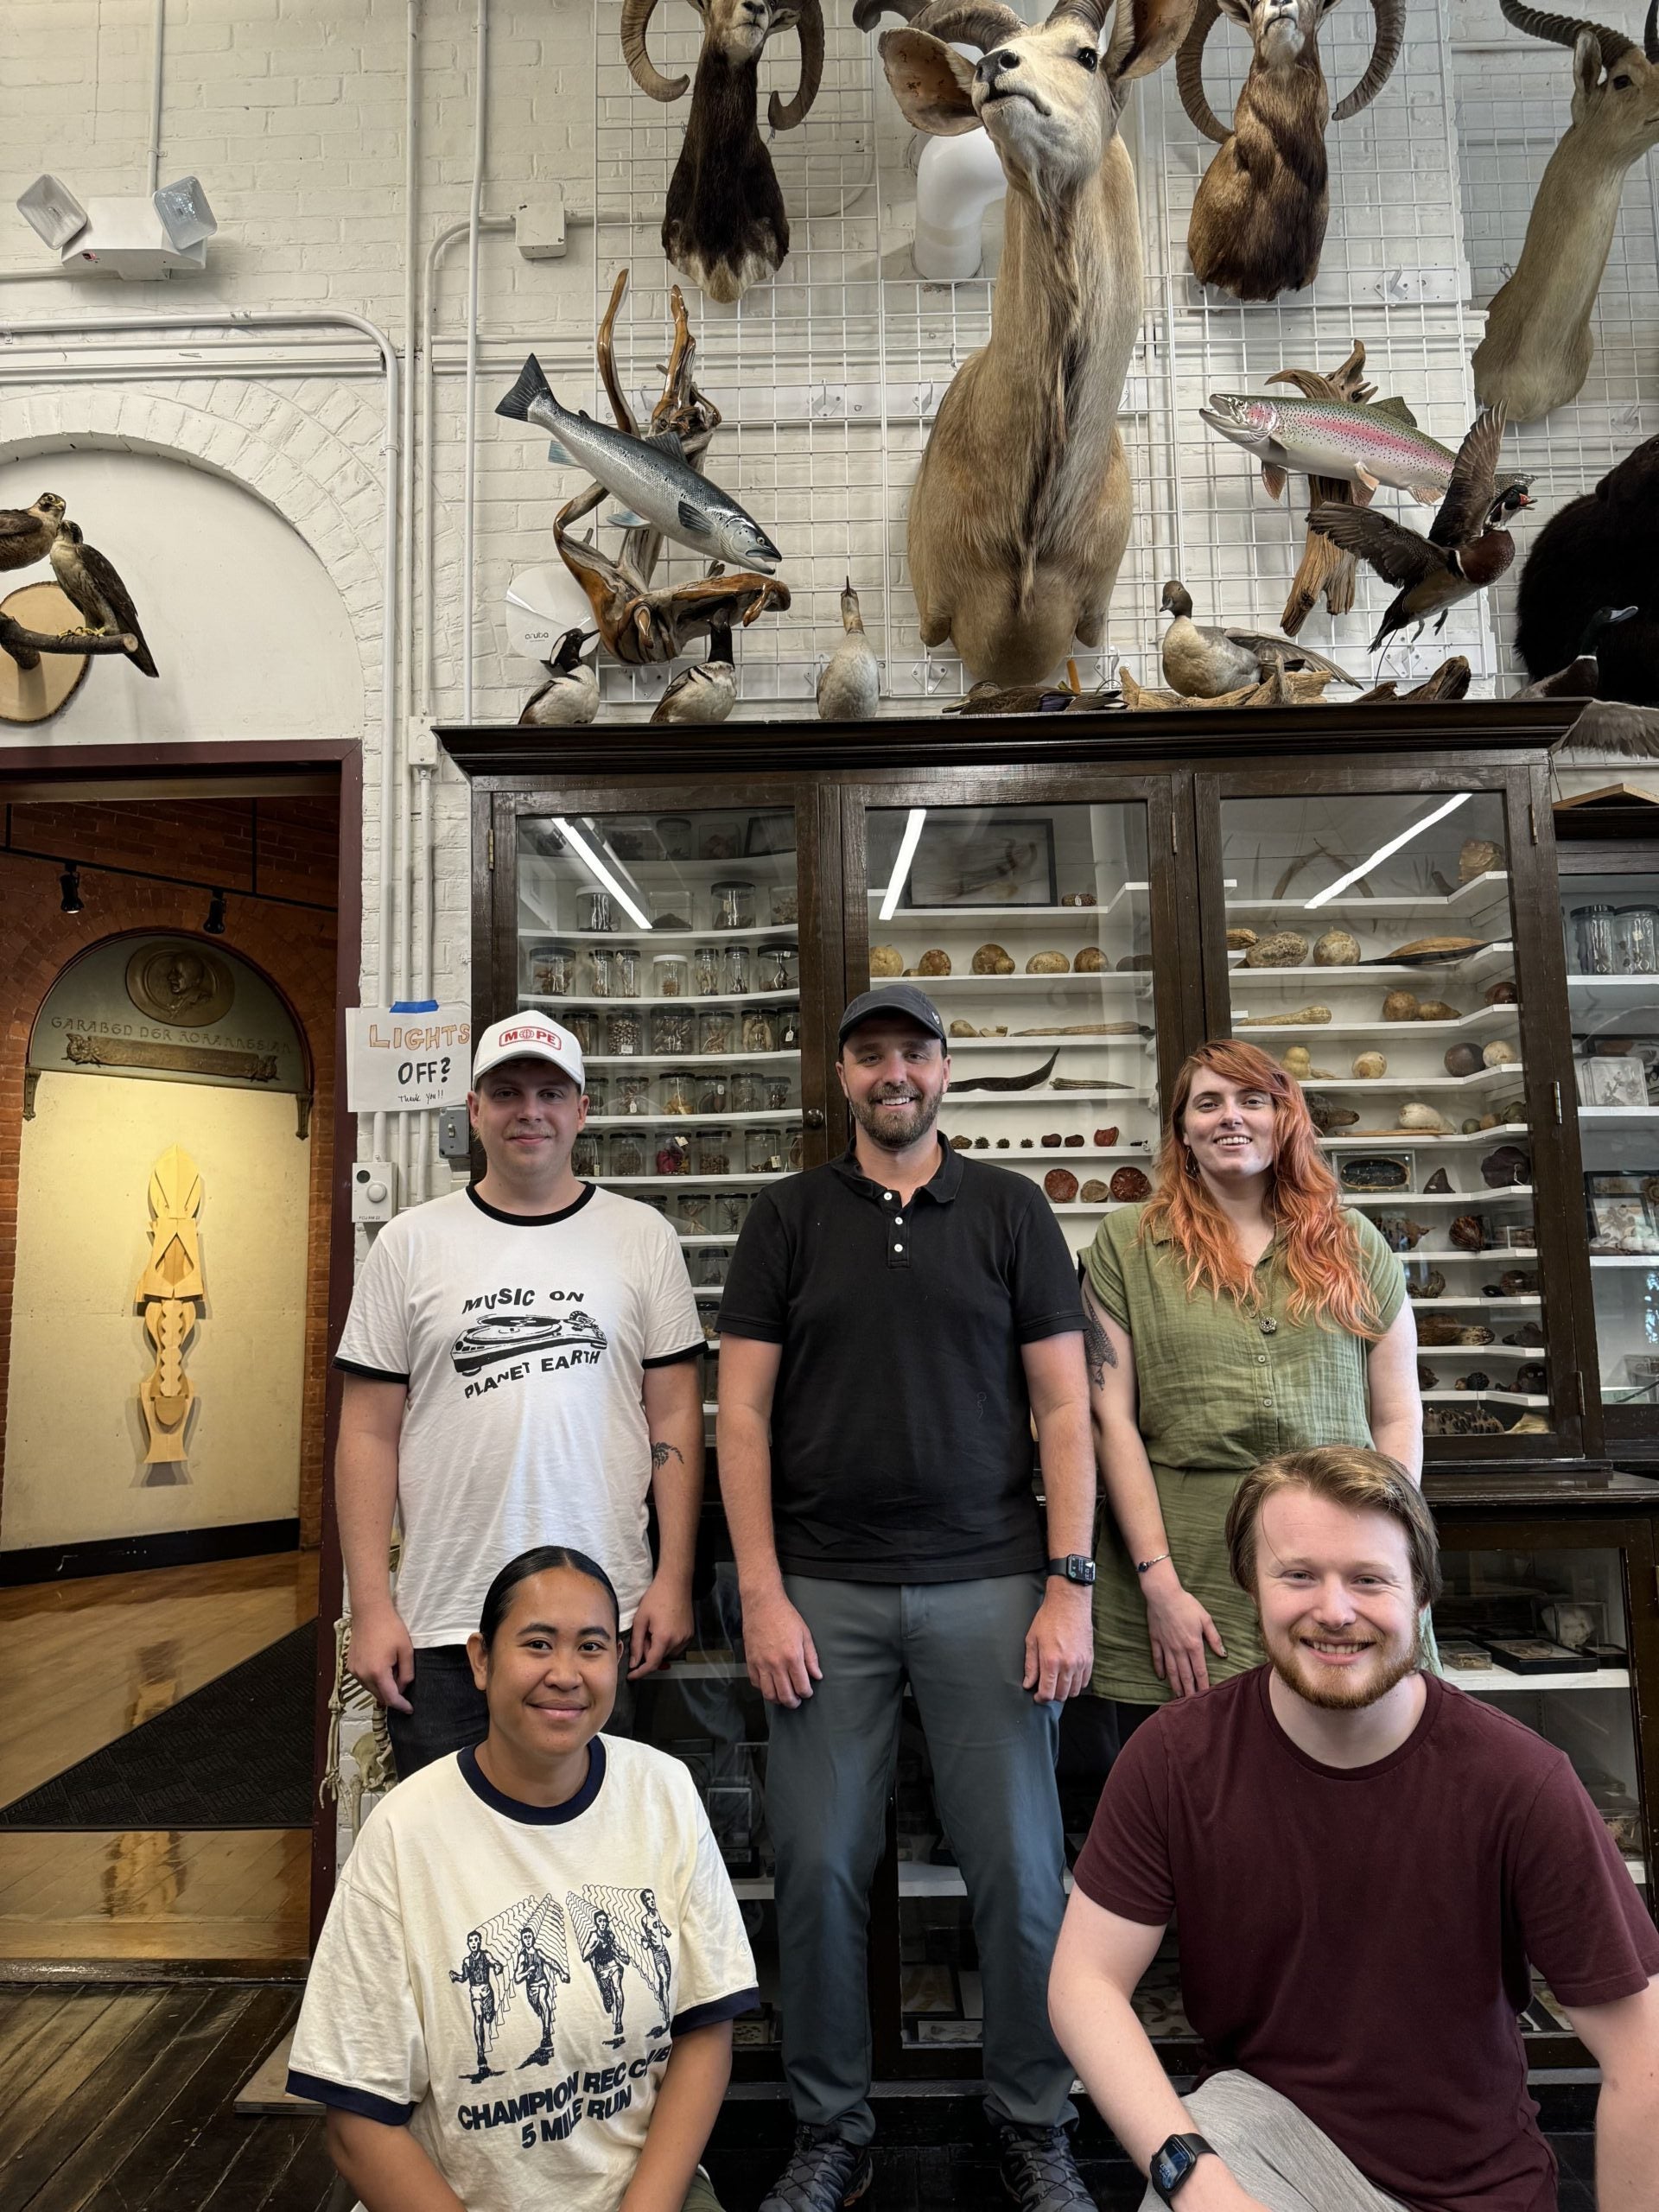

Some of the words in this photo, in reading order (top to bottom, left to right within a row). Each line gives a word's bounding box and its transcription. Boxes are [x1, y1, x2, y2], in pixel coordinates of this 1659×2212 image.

[524, 632, 550, 640] aruba
[51, 1016, 132, 1037] GARABED
[139, 1026, 172, 1041] DER
[369, 1023, 471, 1052] LIGHTS
[397, 1056, 451, 1085] OFF?
[461, 1287, 536, 1315] MUSIC
[549, 1290, 585, 1303] ON
[464, 1362, 531, 1399] PLANET
[540, 1349, 601, 1372] EARTH
[457, 2070, 580, 2131] CHAMPION
[582, 2061, 627, 2094] REC
[521, 2121, 537, 2150] 5
[540, 2096, 584, 2143] MILE
[587, 2083, 632, 2121] RUN
